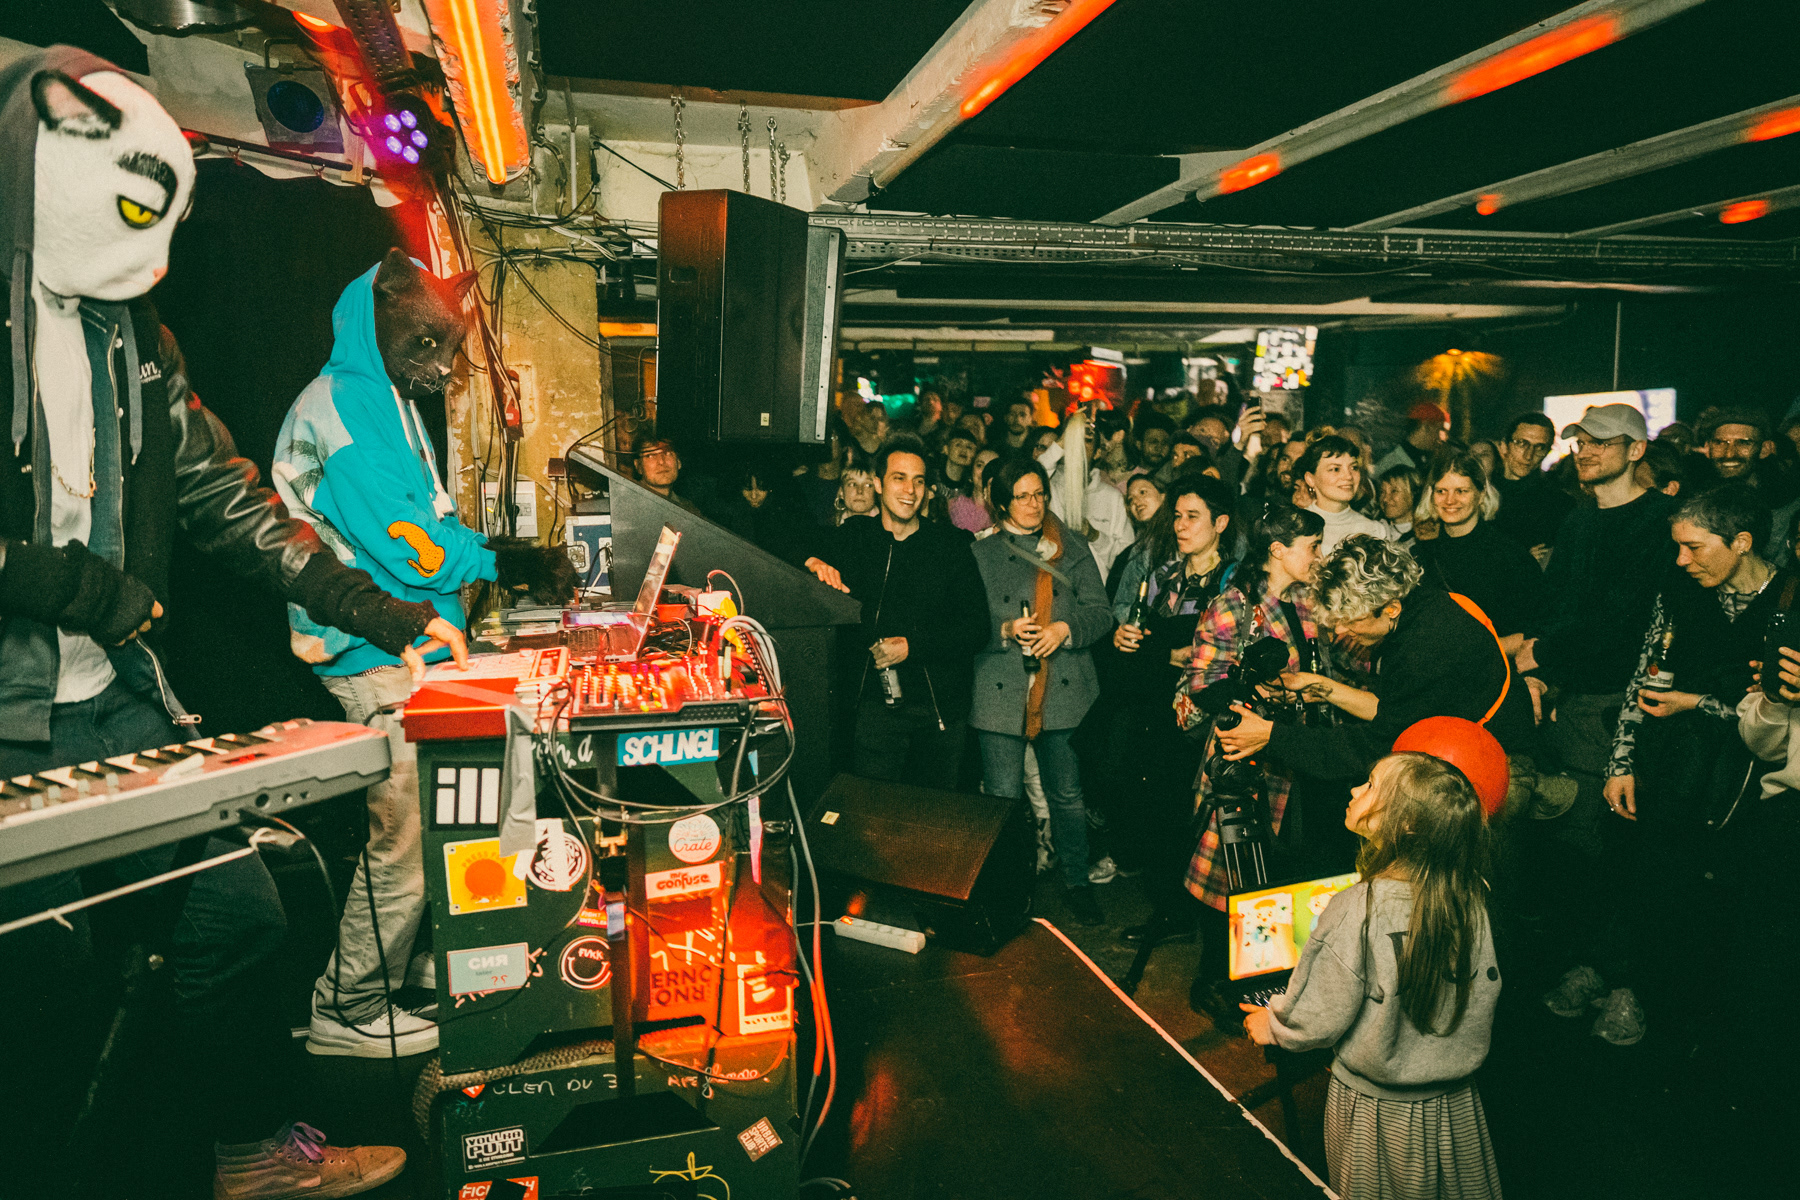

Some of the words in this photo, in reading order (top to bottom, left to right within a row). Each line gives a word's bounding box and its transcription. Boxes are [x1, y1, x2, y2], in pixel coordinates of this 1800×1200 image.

[622, 729, 719, 766] SCHLNGL
[673, 837, 713, 853] Crate
[740, 1131, 757, 1151] CLUB
[748, 1126, 770, 1153] SPORTS
[756, 1120, 778, 1148] URBAN
